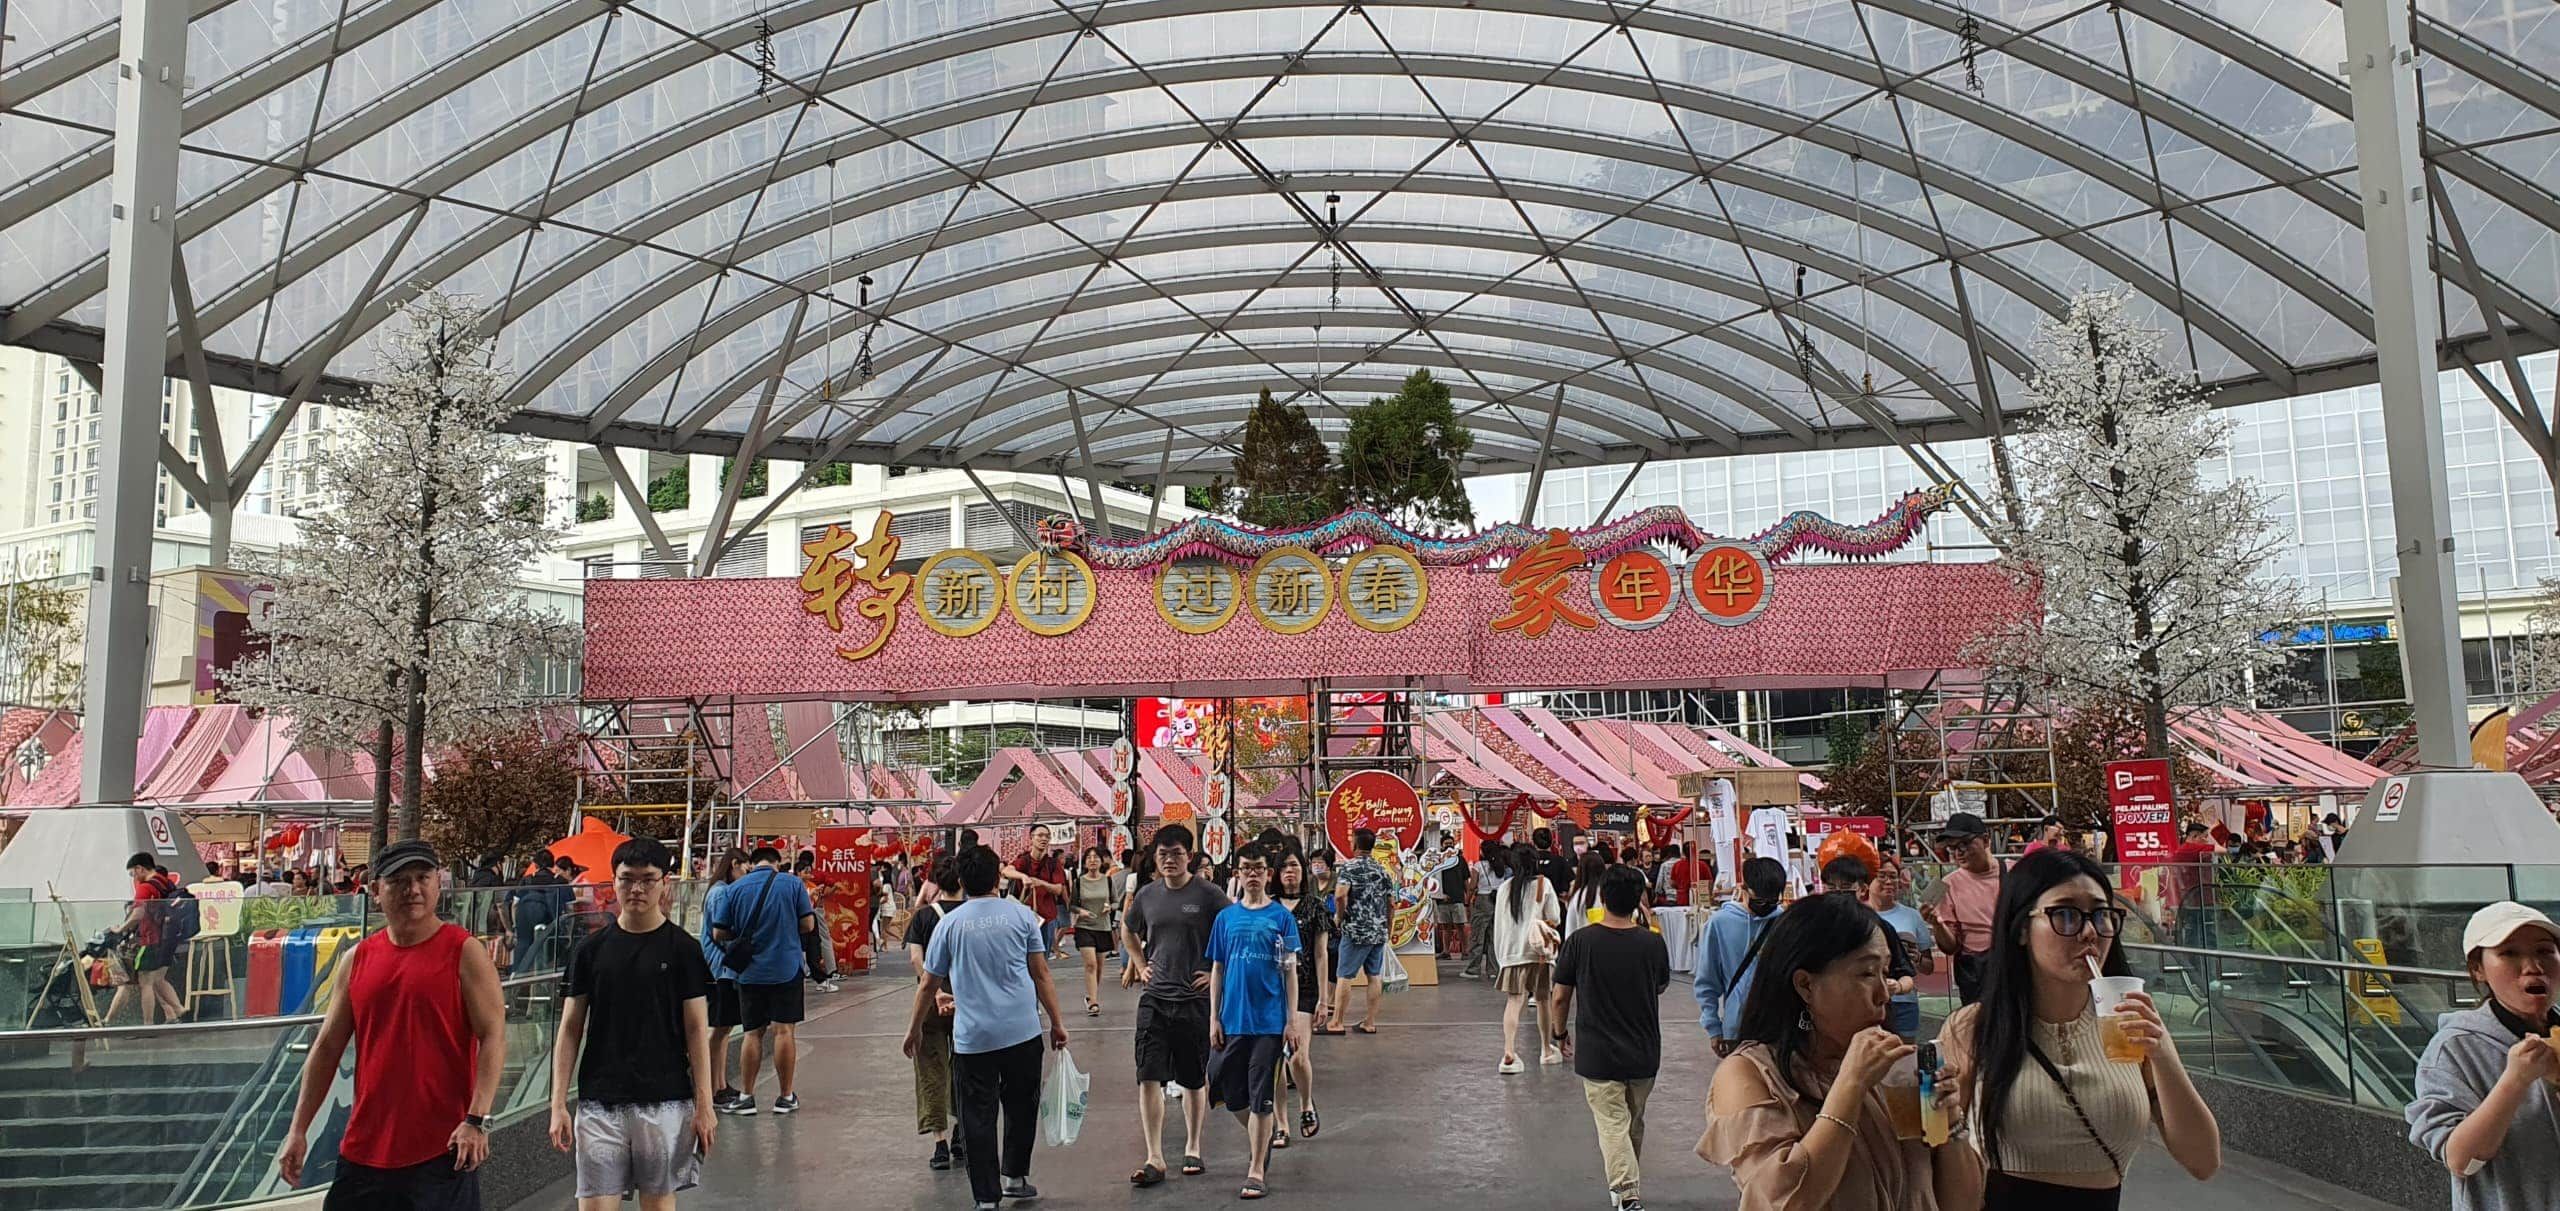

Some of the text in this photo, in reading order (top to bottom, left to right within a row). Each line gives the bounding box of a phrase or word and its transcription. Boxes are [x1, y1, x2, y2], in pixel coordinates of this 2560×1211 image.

[801, 510, 1756, 660] 转新村 过新春 家年华
[1365, 798, 1390, 811] Balik
[2142, 803, 2170, 811] PALING
[1594, 811, 1630, 825] subplace
[2115, 811, 2171, 825] POWER!
[2136, 831, 2161, 849] 35
